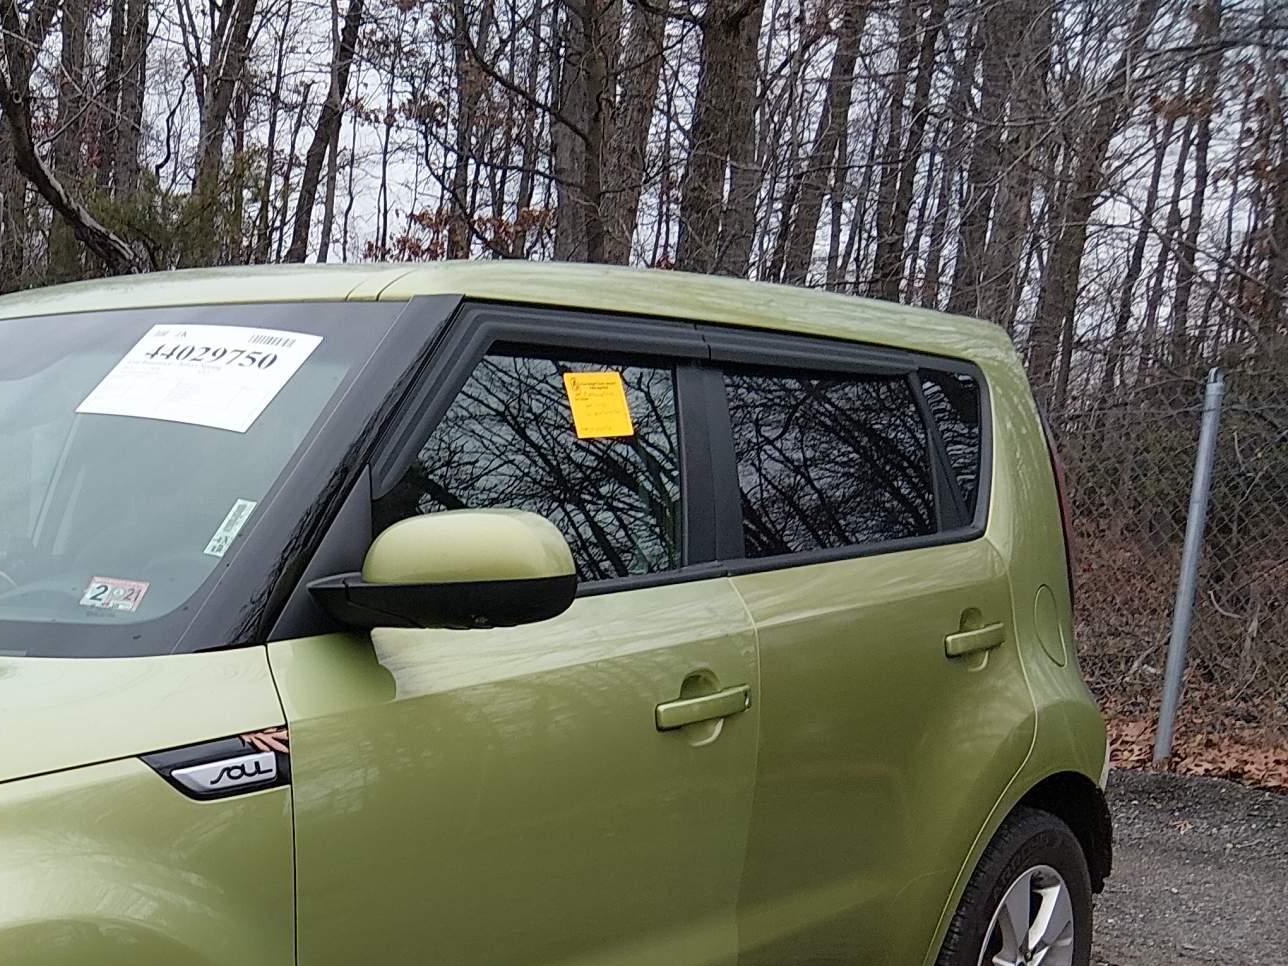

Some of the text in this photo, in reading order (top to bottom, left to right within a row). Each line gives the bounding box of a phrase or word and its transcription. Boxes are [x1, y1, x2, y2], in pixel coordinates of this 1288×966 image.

[145, 344, 278, 370] 44029750
[89, 584, 142, 602] 2 21
